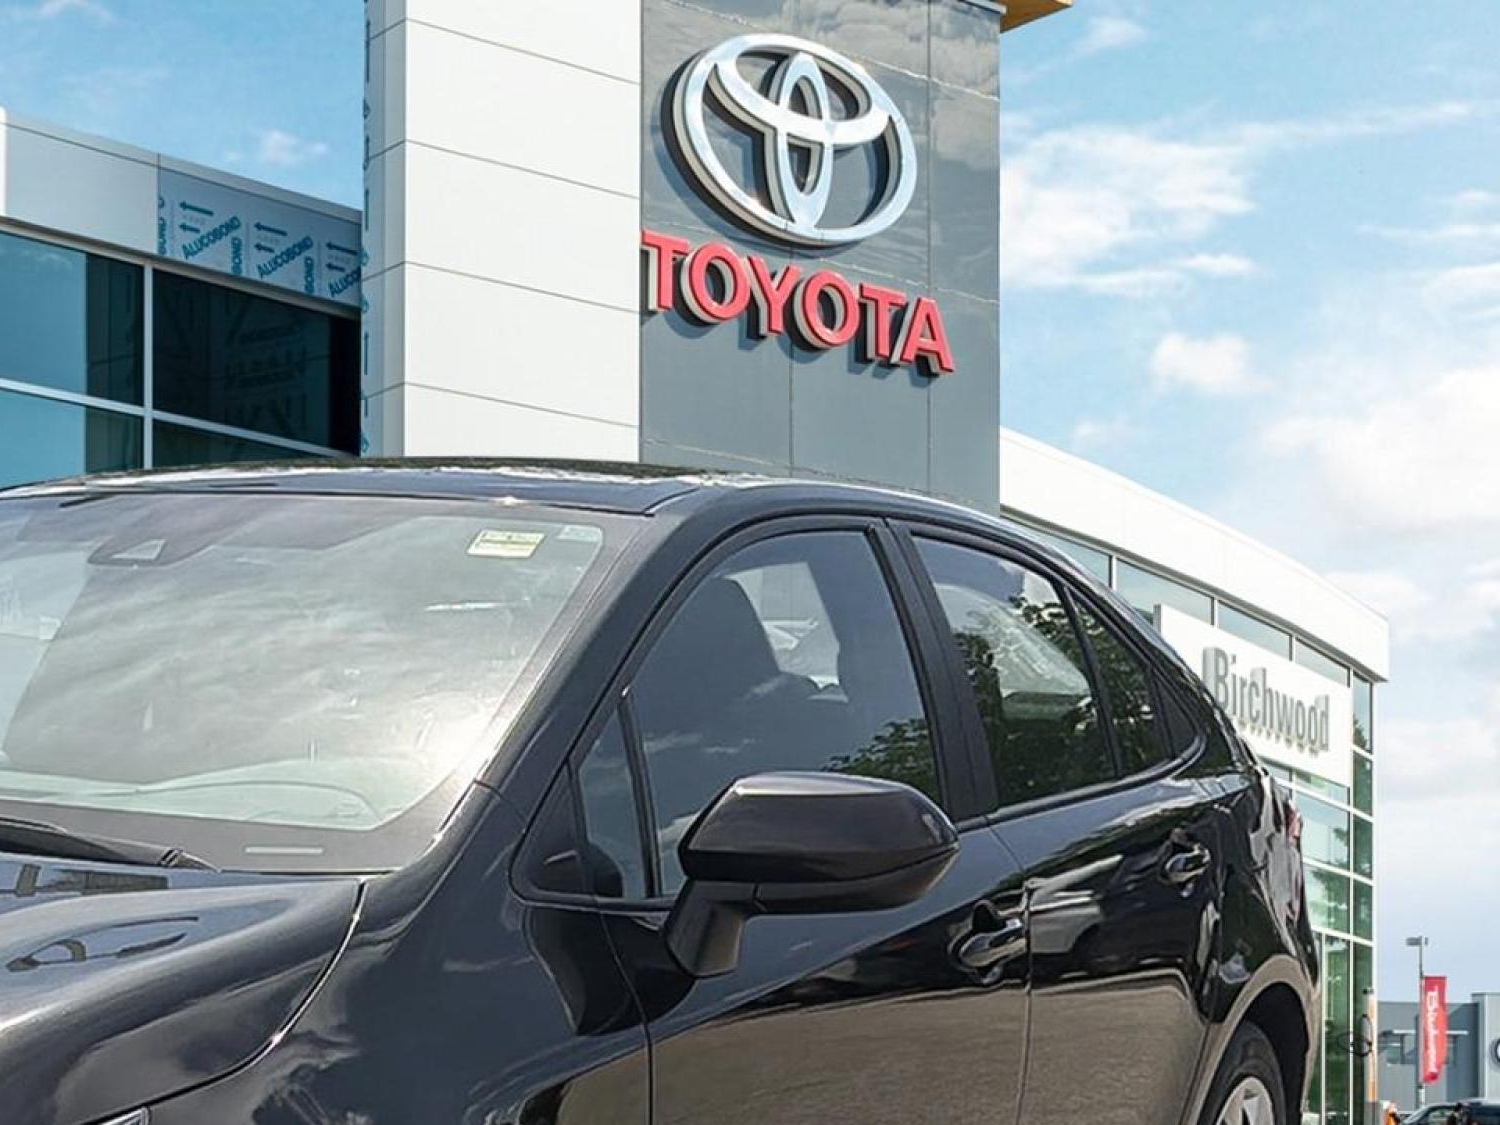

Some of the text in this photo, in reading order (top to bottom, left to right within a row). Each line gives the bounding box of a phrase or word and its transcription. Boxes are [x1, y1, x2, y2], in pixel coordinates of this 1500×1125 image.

[182, 215, 242, 260] ALUCOBOND
[257, 235, 314, 278] ALUCOBOND
[641, 229, 955, 373] TOYOTA
[1204, 647, 1329, 752] Birchwood
